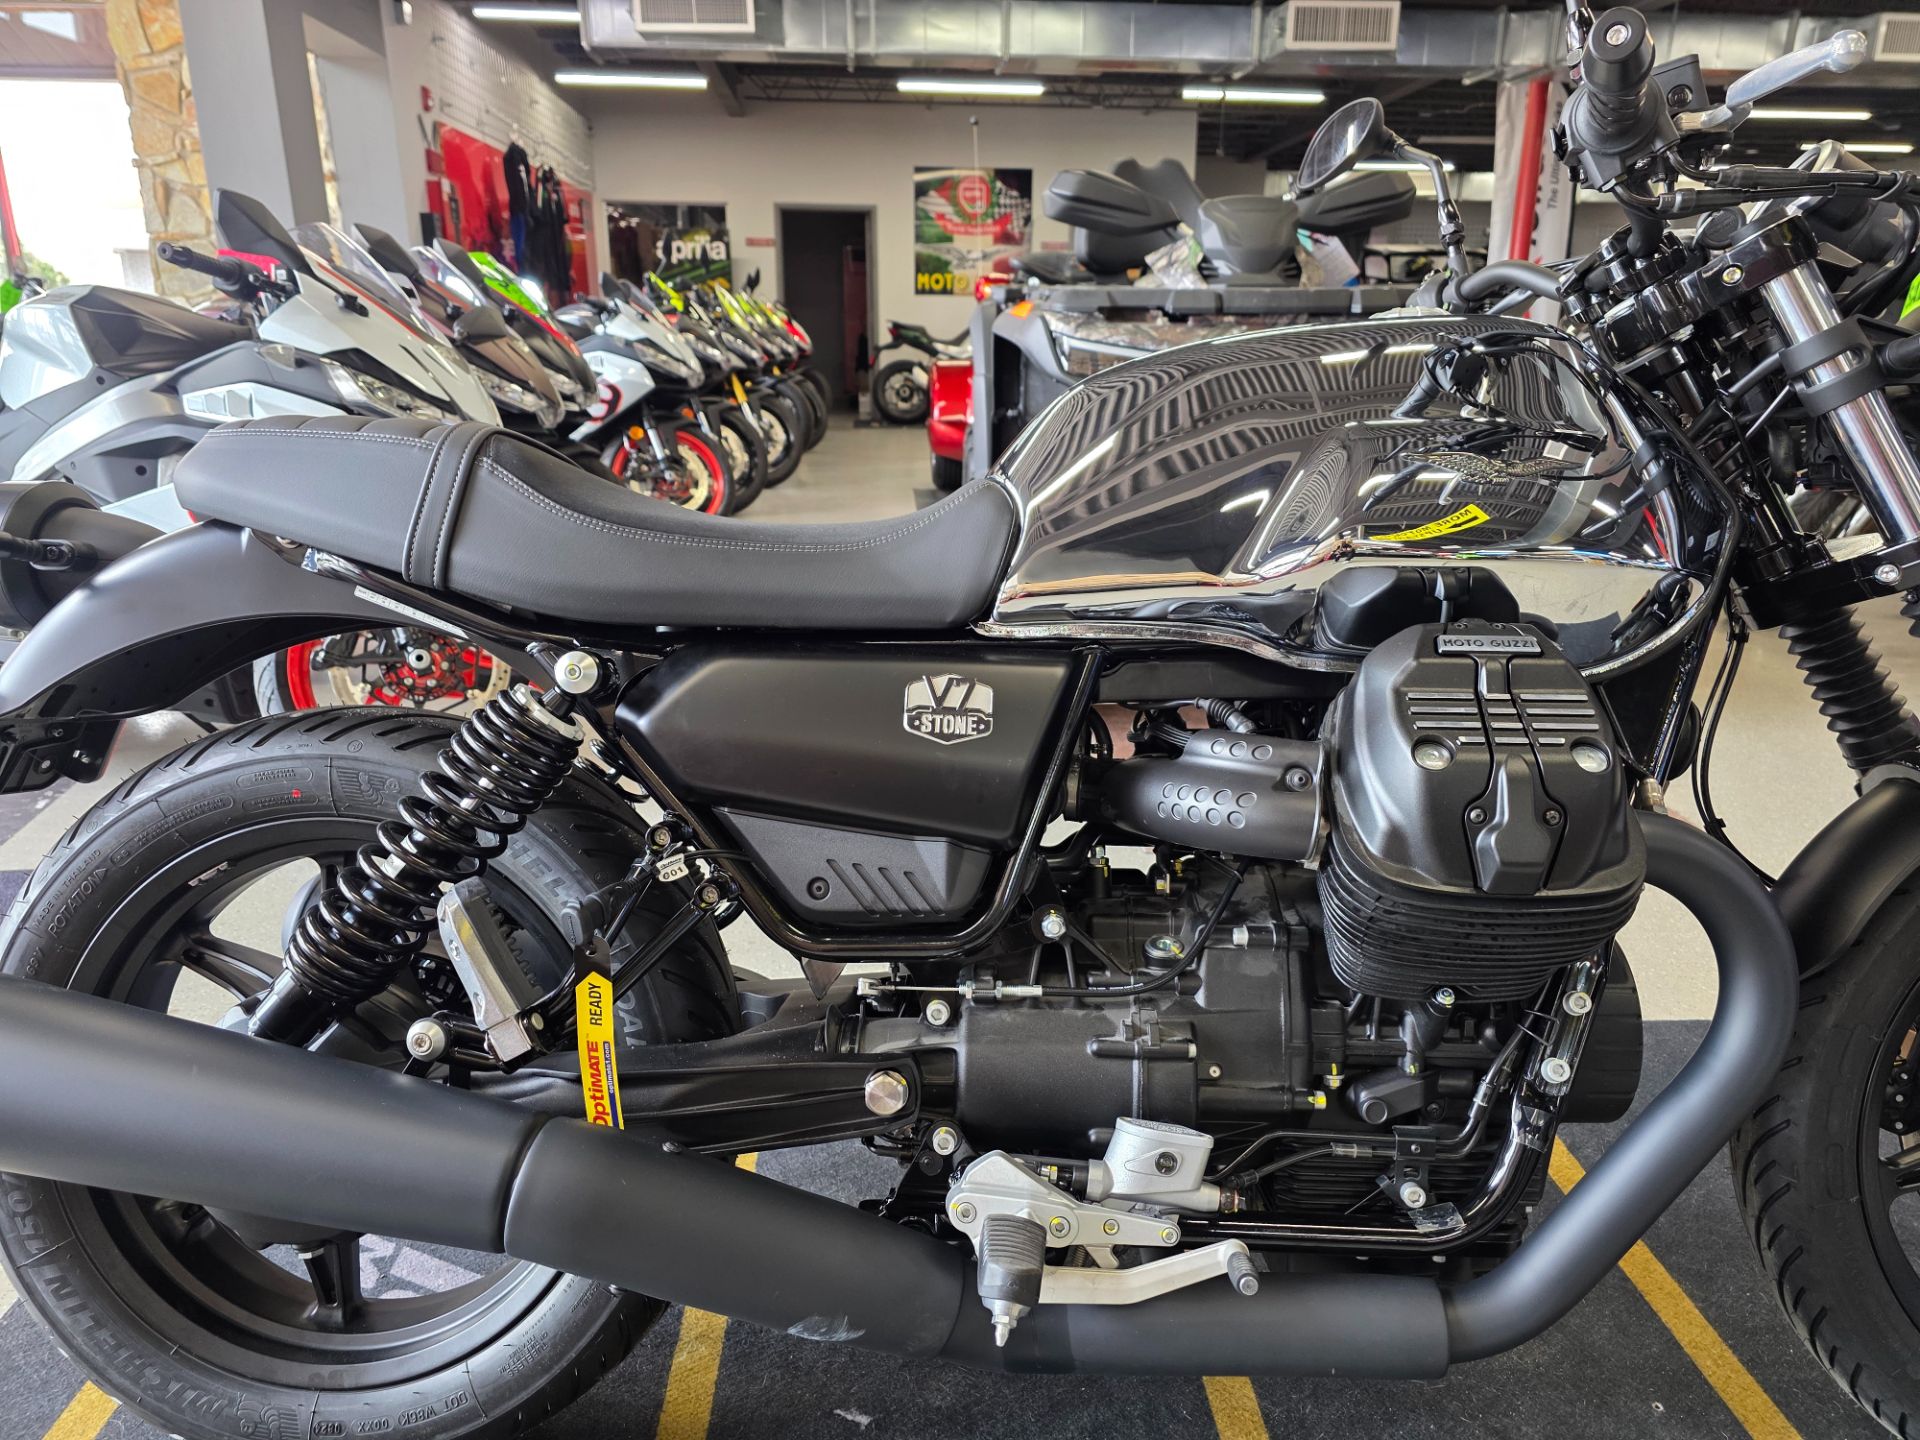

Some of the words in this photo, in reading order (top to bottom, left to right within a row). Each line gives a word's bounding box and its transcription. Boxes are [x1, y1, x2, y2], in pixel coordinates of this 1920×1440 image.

[917, 272, 970, 291] MOTO
[1443, 639, 1484, 647] MOTO
[1490, 640, 1535, 648] GUZZI
[922, 675, 976, 711] V7
[920, 713, 978, 736] STONE
[62, 849, 102, 888] THAILAND
[47, 871, 101, 938] ROTATION
[588, 982, 603, 1026] READY
[604, 1042, 614, 1094] optimate1.com
[43, 1273, 228, 1420] MICHELIN
[443, 1391, 468, 1412] DOT
